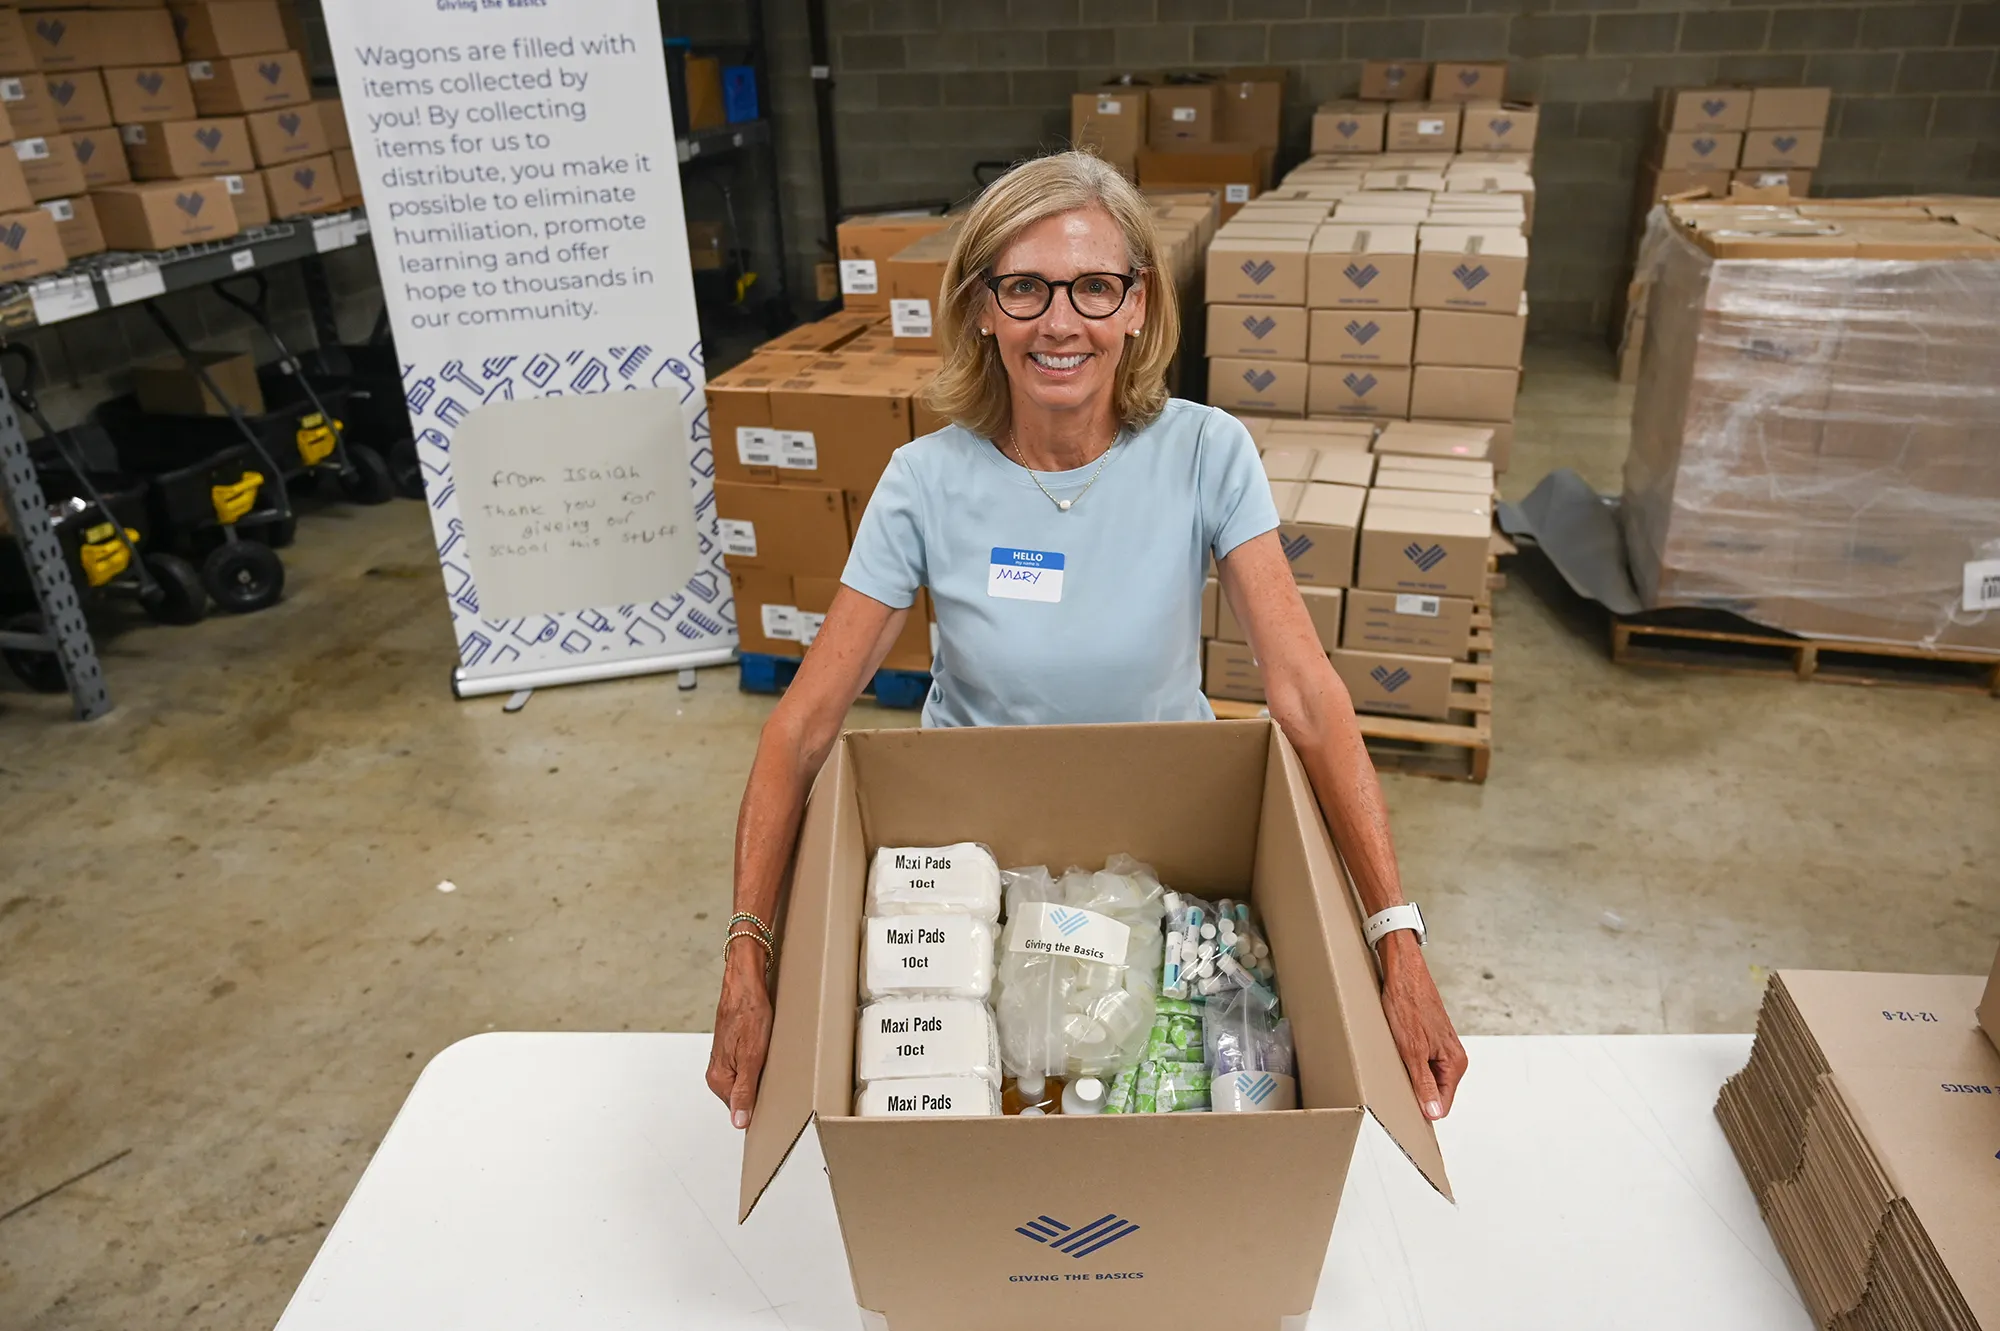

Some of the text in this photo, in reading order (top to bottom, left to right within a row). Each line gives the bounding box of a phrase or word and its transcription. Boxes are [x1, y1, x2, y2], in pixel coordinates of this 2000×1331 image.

[355, 34, 636, 69] Wagons are filled with
[364, 68, 588, 98] items collected by
[368, 99, 586, 132] you! By collecting
[376, 133, 550, 158] items for us to
[382, 153, 651, 187] distribute, you make it
[389, 185, 636, 220] possible to eliminate
[394, 214, 646, 245] humiliation, promote
[399, 242, 609, 273] learning and offer
[405, 266, 654, 303] hope to thousands in
[411, 299, 598, 329] our community.
[563, 499, 596, 513] you
[1013, 552, 1043, 562] HELLO
[996, 568, 1041, 584] MARY
[895, 855, 951, 870] Maxi Pads
[909, 879, 935, 889] 10ct
[887, 928, 945, 944] Maxi Pads
[1025, 939, 1104, 959] Giving the Basics
[901, 957, 929, 968] 10ct
[881, 1016, 942, 1034] Maxi Pads
[1882, 1010, 1938, 1022] 12-12-6
[896, 1044, 925, 1057] 10ct
[1941, 1083, 1992, 1094] BASICS
[887, 1094, 952, 1112] Maxi Pads
[1009, 1272, 1144, 1282] GIVING THE BASICS
